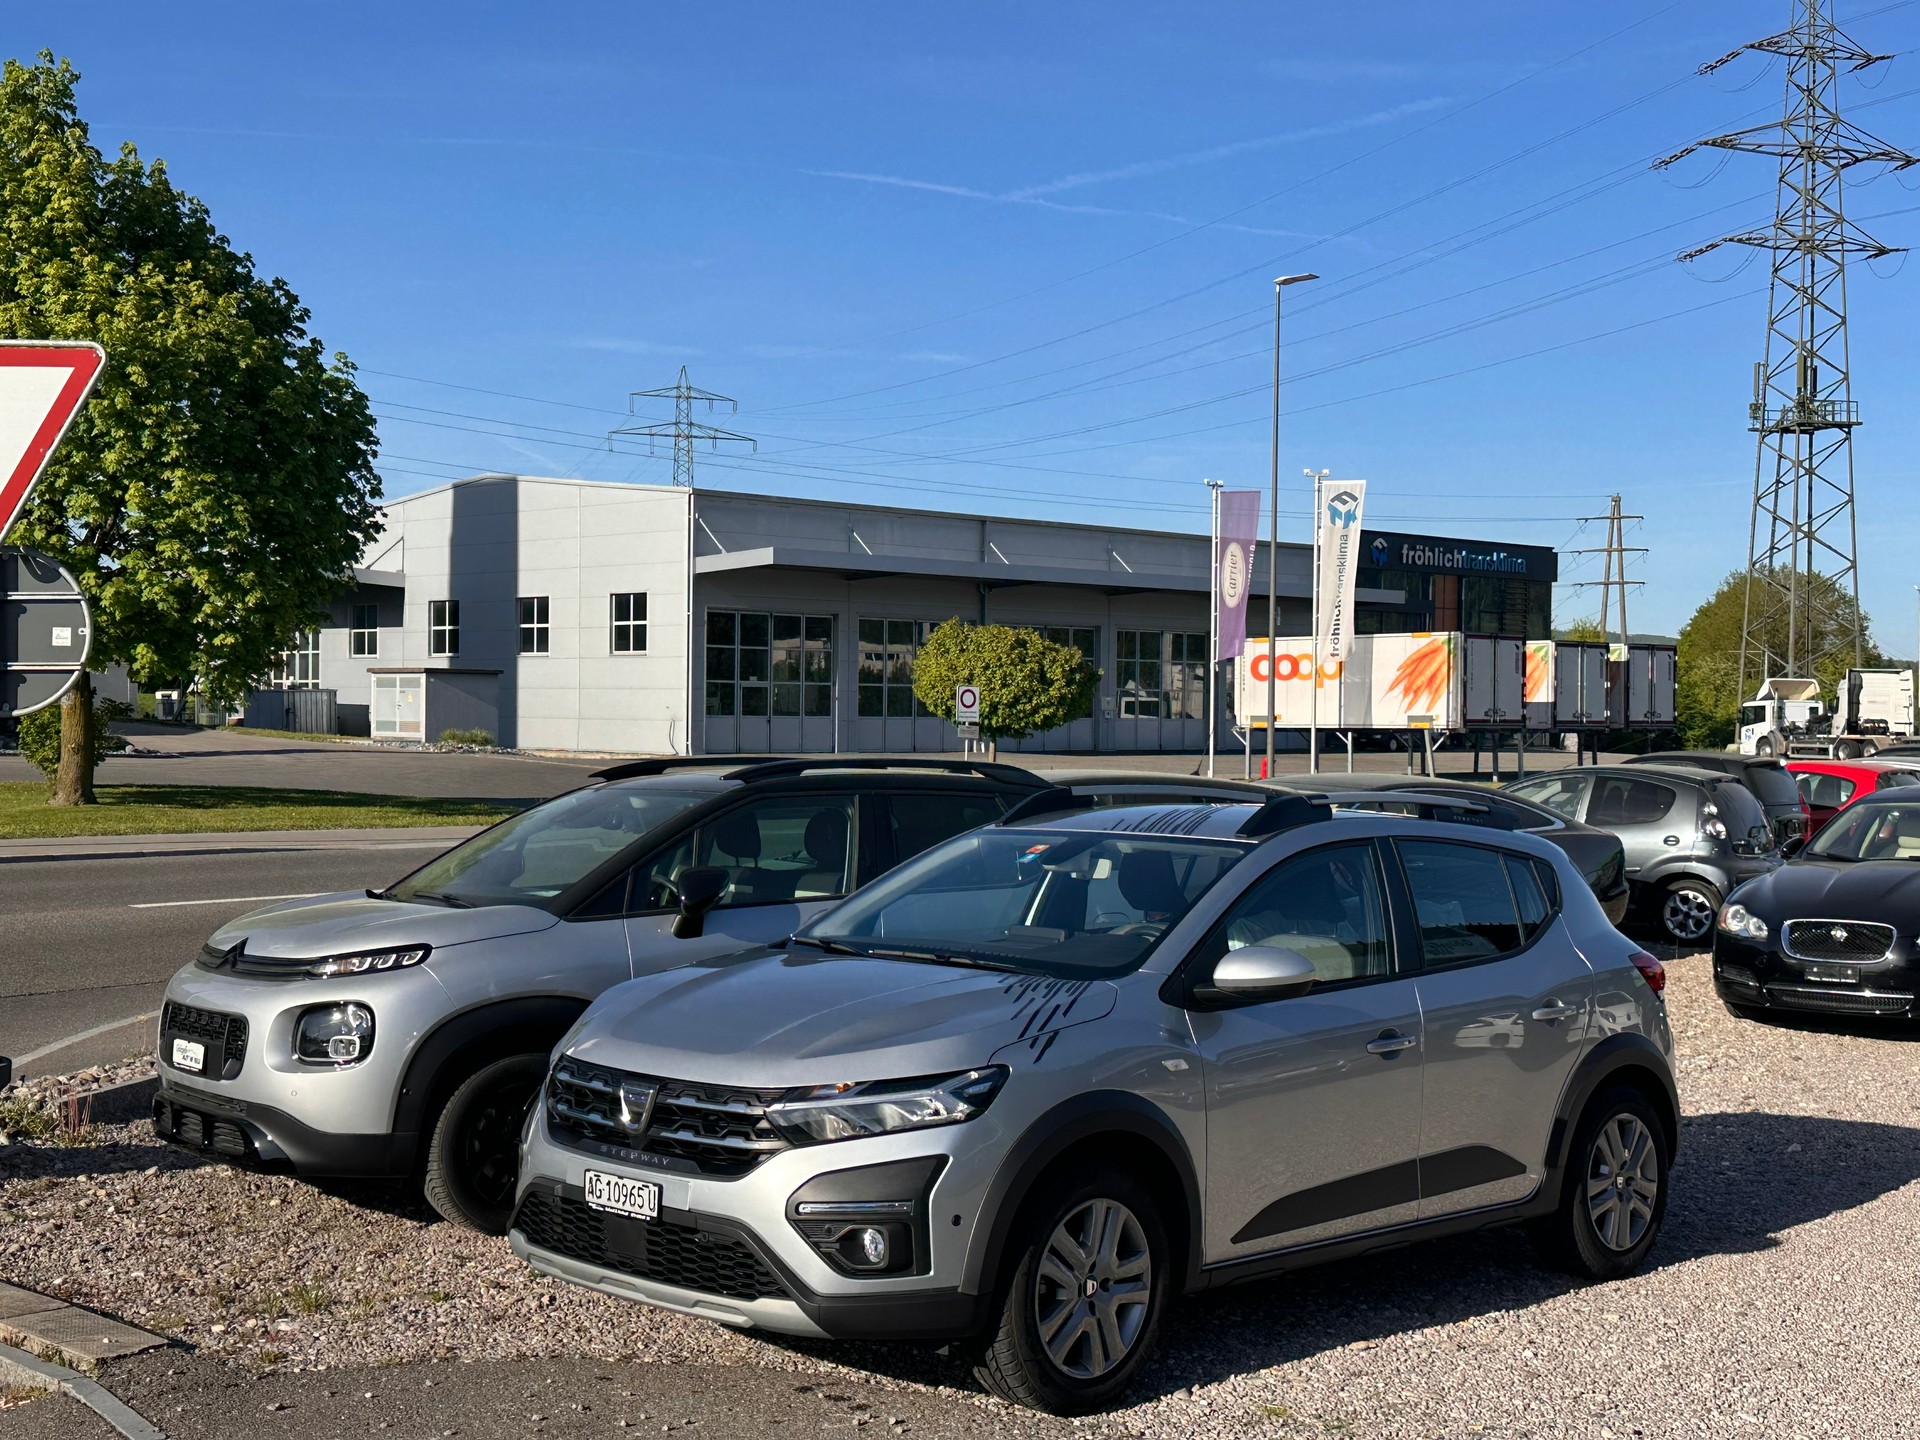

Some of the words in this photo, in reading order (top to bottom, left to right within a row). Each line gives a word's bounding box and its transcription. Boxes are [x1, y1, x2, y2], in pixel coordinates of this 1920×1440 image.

[1227, 551, 1238, 598] Carrier
[1251, 653, 1344, 688] coop
[600, 1145, 670, 1165] STEPWAY
